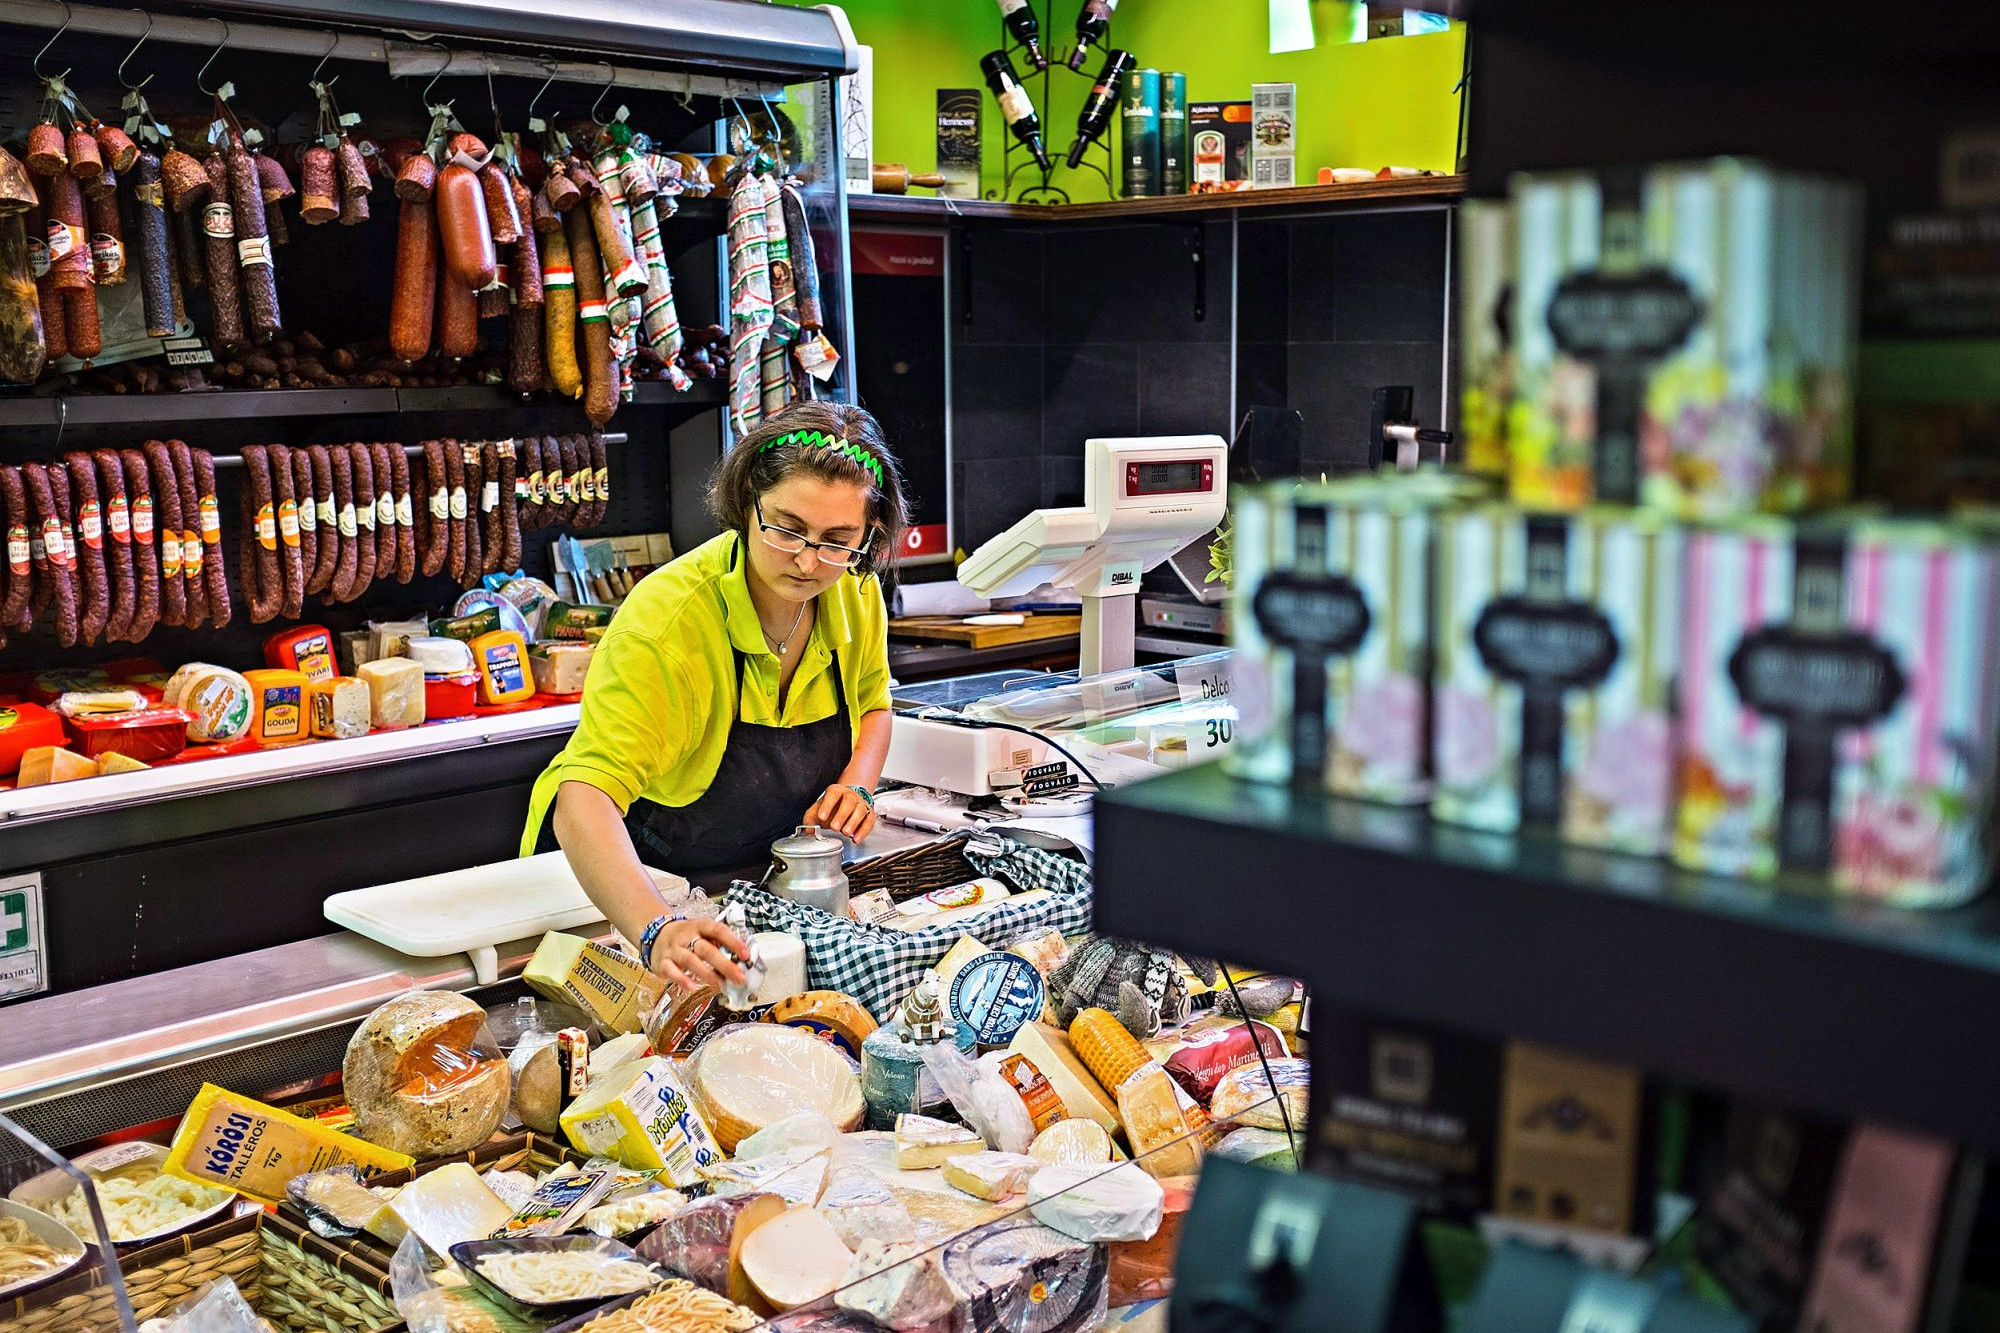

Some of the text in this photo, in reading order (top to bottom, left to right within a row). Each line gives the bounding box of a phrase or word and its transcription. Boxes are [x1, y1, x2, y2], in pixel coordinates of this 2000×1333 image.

[1111, 572, 1133, 582] DIBAL
[266, 718, 296, 727] GOUDA
[1028, 764, 1061, 777] FOGVÁJÓ
[1033, 777, 1072, 790] FOGVÁJÓ
[984, 953, 1005, 961] MAINE
[573, 963, 623, 1004] LE GRUYÈRE
[882, 1068, 906, 1080] Volcan
[647, 1092, 688, 1145] Mondiet
[204, 1112, 253, 1176] KŐRÖSI
[229, 1119, 267, 1180] TALLÉROS
